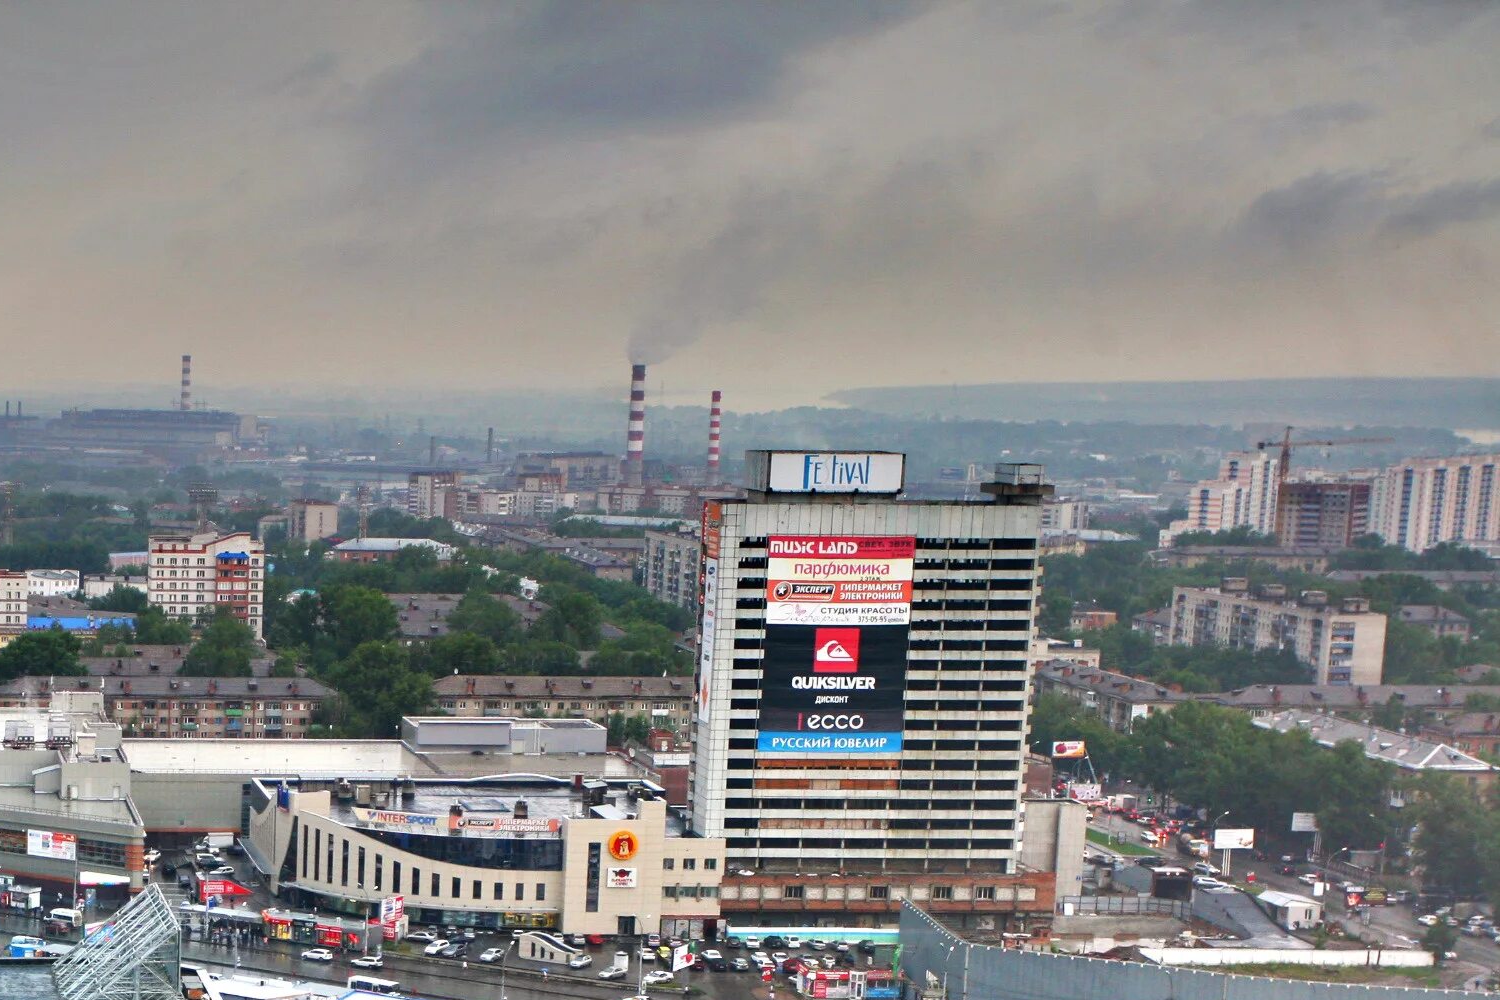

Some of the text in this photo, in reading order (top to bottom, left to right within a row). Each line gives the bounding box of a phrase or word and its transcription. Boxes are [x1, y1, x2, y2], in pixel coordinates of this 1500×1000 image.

[818, 541, 859, 555] LAND
[794, 561, 890, 579] парфюмика
[794, 583, 903, 594] ЭКСПЕРТ ГИПЕРМАРКЕТ
[840, 591, 903, 600] ЭЛЕКТРОНИКИ
[820, 606, 908, 615] СТУДИЯ КРАСОТЫ
[791, 676, 876, 690] QUIKSILVER
[814, 695, 849, 705] ДИСКОНТ
[807, 714, 864, 730] ecco
[772, 736, 888, 748] РУССКИЙ ЮВЕЛИР
[377, 812, 438, 826] INTERSPORT
